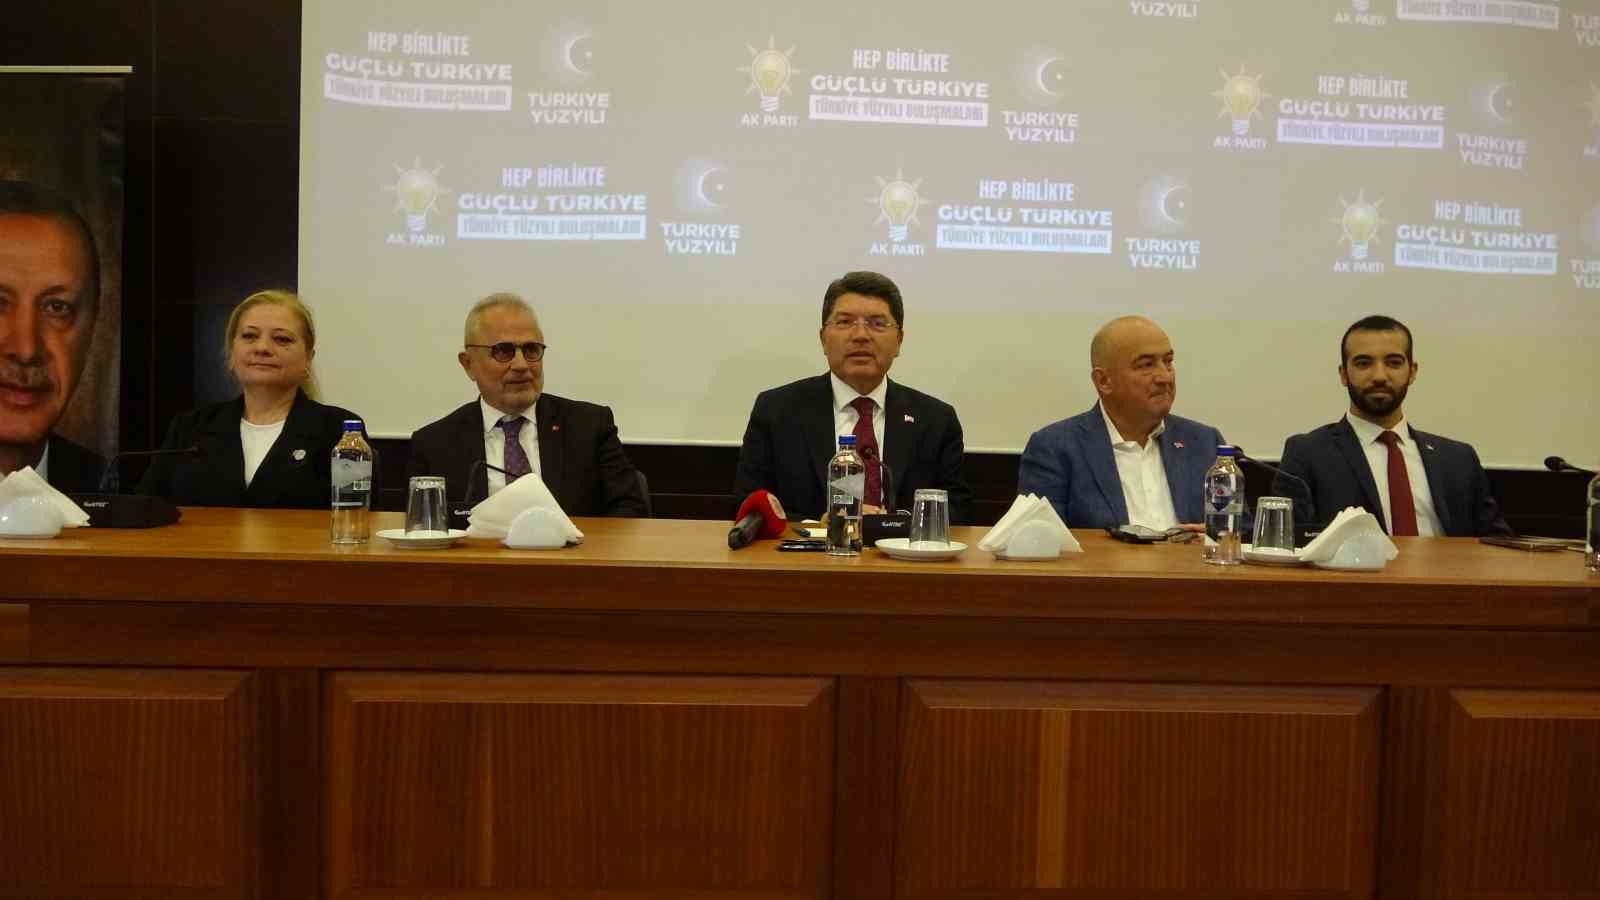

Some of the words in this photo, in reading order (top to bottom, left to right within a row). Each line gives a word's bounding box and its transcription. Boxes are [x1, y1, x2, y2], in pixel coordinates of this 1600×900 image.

[368, 31, 398, 52] HEP
[853, 49, 881, 69] HEP
[886, 48, 950, 72] BİRLİKTE
[810, 74, 887, 96] GÜÇLÜ
[894, 77, 991, 98] TÜRKİYE
[1318, 75, 1345, 96] HEP
[1350, 74, 1408, 98] BİRLİKTE
[741, 112, 759, 126] AK
[502, 166, 532, 187] HEP
[537, 163, 606, 188] BİRLİKTE
[978, 179, 1008, 199] HEP
[1012, 178, 1074, 201] BİRLİKTE
[938, 204, 1013, 226] GÜÇLÜ
[1019, 206, 1112, 225] TÜRKİYE
[1435, 200, 1461, 220] HEP
[870, 243, 888, 256] AK
